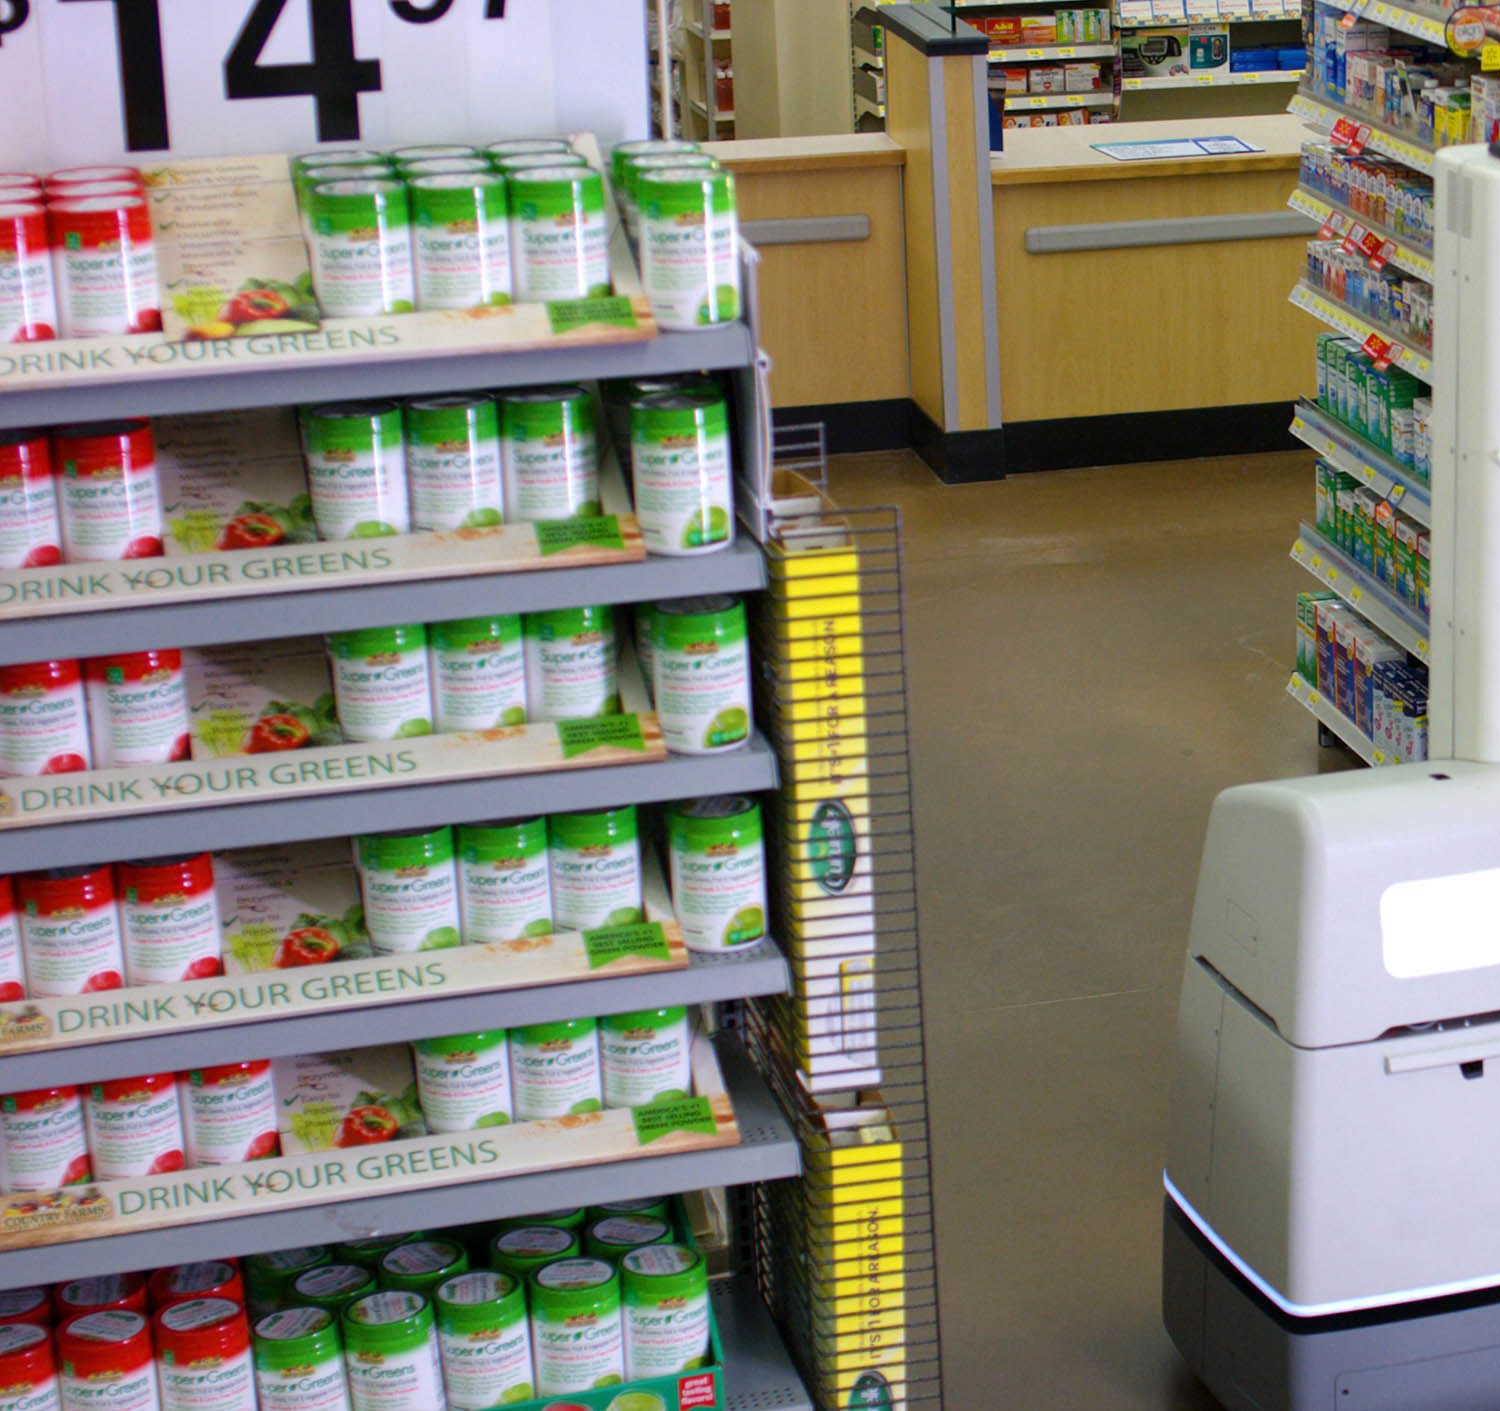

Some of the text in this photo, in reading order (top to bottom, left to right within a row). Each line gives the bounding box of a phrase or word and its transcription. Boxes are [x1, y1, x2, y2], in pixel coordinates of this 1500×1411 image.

[122, 338, 235, 365] YOUR
[245, 325, 401, 355] GREENS
[121, 562, 240, 591] YOUR
[240, 548, 392, 581] GREENS
[30, 694, 74, 714] Greens
[108, 683, 148, 707] Super
[20, 750, 418, 812] DRINK YOUR GREENS
[170, 900, 211, 924] Greens
[68, 916, 111, 936] Greens
[57, 961, 447, 1034] DRINK YOUR GREENS
[638, 1037, 680, 1057] Greens
[460, 1059, 502, 1080] Greens
[118, 1139, 499, 1216] DRINK YOUR GREENS
[3, 1204, 106, 1230] COUNTRY FARMS
[485, 1333, 525, 1356] Greens
[205, 1363, 247, 1385] Greens
[298, 1370, 339, 1392] Greens
[369, 1363, 416, 1379] Greens
[105, 1375, 148, 1397] Greens
